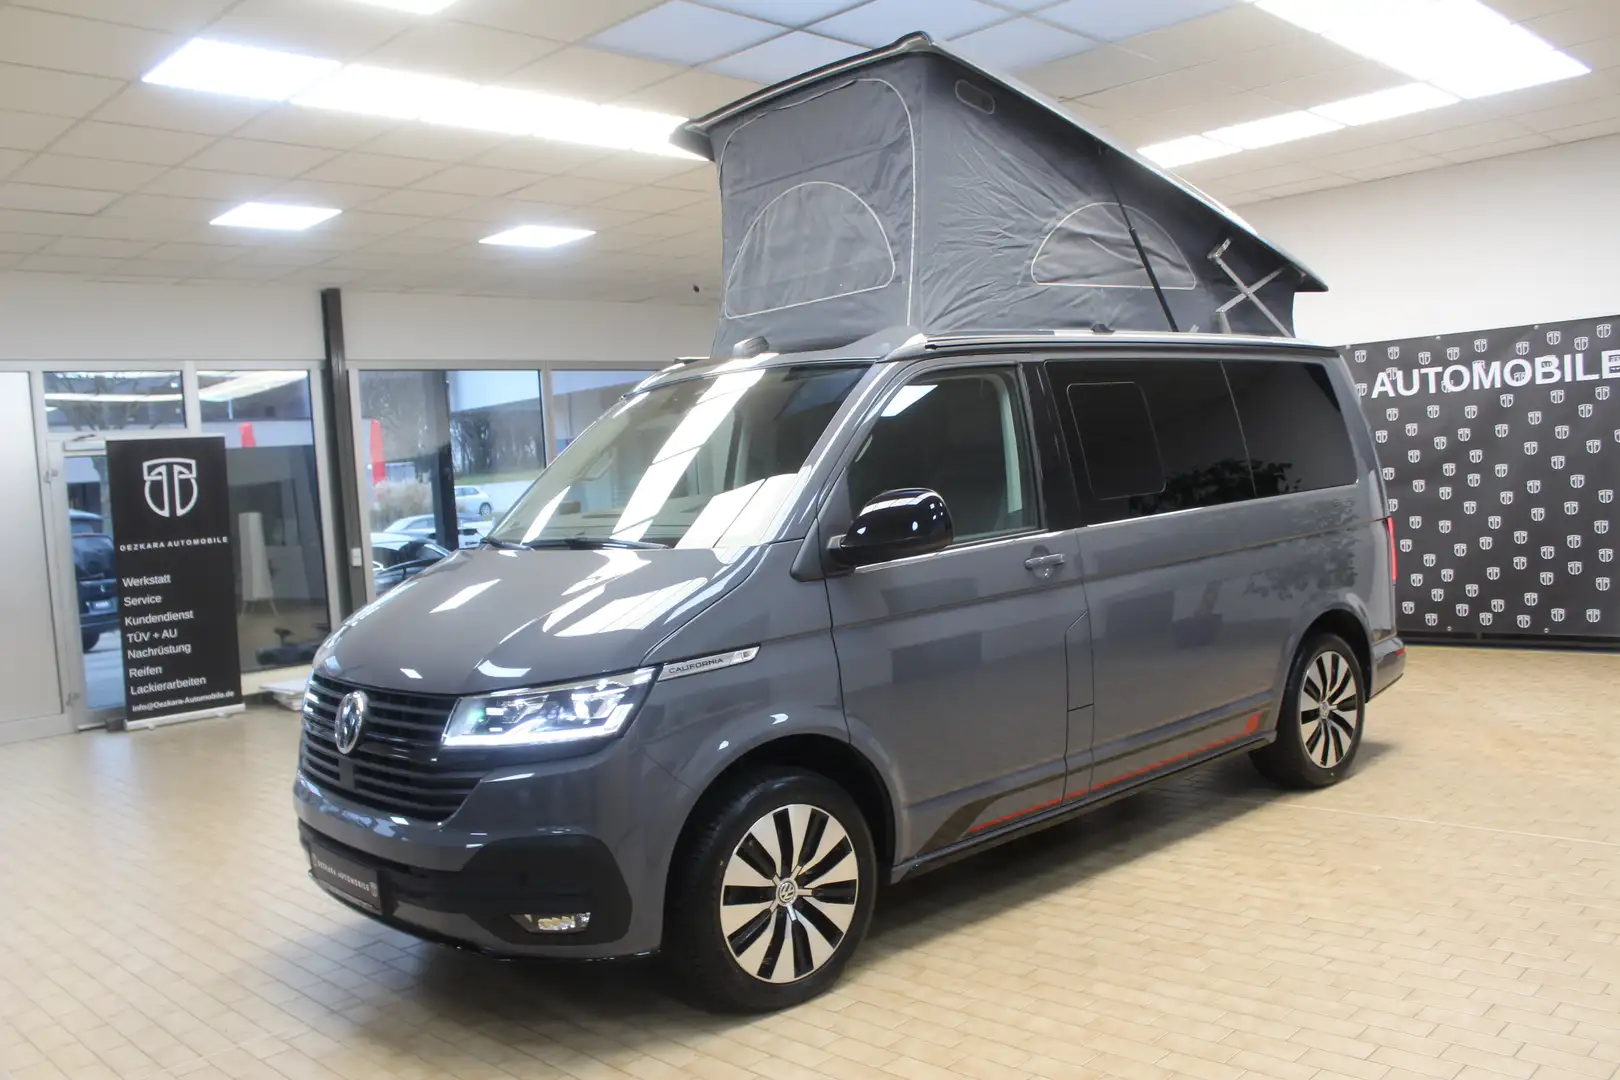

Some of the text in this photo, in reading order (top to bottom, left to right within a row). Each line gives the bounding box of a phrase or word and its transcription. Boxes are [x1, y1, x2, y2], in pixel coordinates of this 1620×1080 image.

[1371, 350, 1620, 398] AUTOMOBILE
[120, 536, 228, 552] OEZKARA AUTOMOBILE
[122, 574, 171, 587] Werkstatt
[124, 594, 162, 607] Service
[125, 610, 194, 626] Kundendienst
[127, 631, 150, 643] TÜV
[161, 628, 177, 639] AU
[128, 643, 192, 659] Nachrüstung
[129, 665, 162, 678] Reifen
[669, 658, 724, 674] CALIFORNIA
[130, 676, 207, 695] Lackierarbeiten
